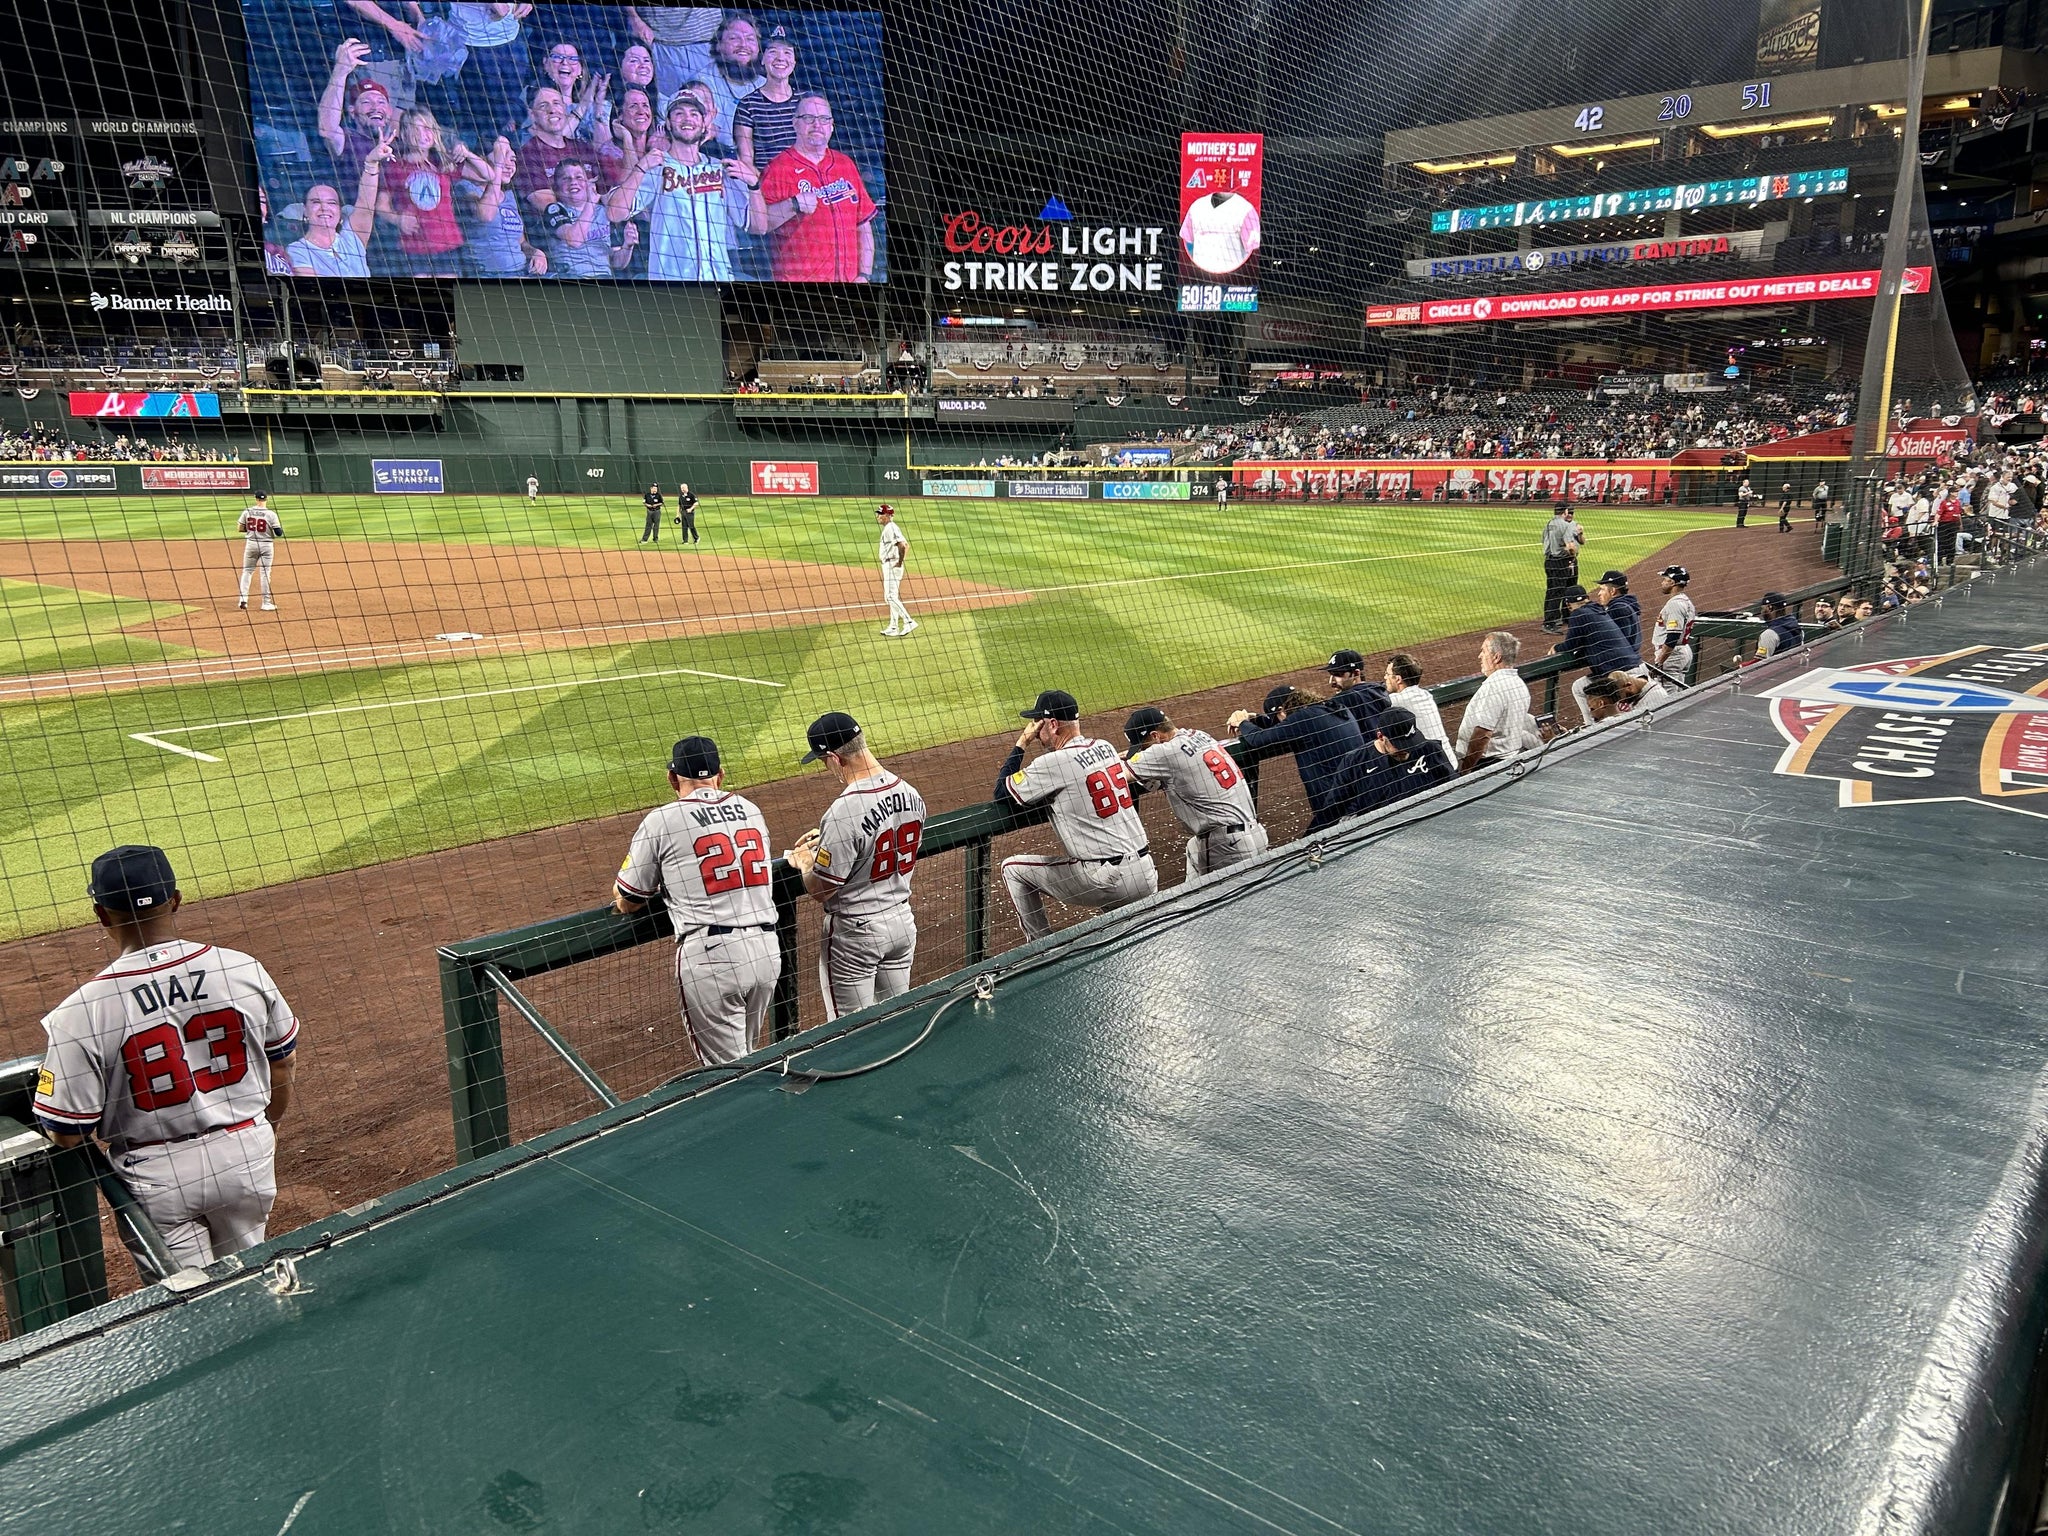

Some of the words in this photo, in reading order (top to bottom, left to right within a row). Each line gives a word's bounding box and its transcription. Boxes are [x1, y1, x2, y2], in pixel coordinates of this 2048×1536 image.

[1741, 82, 1771, 110] 51
[1657, 94, 1692, 121] 20
[1574, 106, 1603, 132] 42
[3, 121, 68, 133] CHAMPIONS
[92, 122, 128, 133] WORLD
[132, 122, 197, 134] CHAMPIONS
[1187, 142, 1236, 155] MOTHER'S
[1238, 142, 1257, 156] DAY
[662, 166, 722, 192] Braves
[1832, 169, 1846, 178] GB
[1743, 178, 1756, 187] GB
[1798, 184, 1806, 194] 3
[1815, 183, 1823, 192] 3
[1828, 180, 1848, 191] 2.0
[1709, 193, 1717, 203] 3
[1726, 192, 1733, 202] 3
[1739, 189, 1757, 200] 2.0
[1629, 202, 1636, 211] 3
[1644, 200, 1651, 210] 3
[0, 212, 15, 224] LD
[18, 212, 49, 224] CARD
[110, 212, 126, 224] NL
[129, 212, 197, 224] CHAMPIONS
[943, 210, 1054, 254] Coors
[1061, 226, 1163, 255] LIGHT
[114, 244, 152, 254] CHAMPIONS
[1431, 255, 1522, 277] ESTRELLA
[1633, 236, 1729, 261] CANTINA
[943, 261, 1059, 291] STRIKE
[1070, 262, 1163, 291] ZONE
[1223, 293, 1258, 302] AVNET
[1501, 297, 1577, 313] DOWNLOAD
[1580, 294, 1609, 308] OUR
[1612, 291, 1640, 306] APP
[1642, 289, 1671, 304] FOR
[1674, 286, 1730, 301] STRIKE
[1731, 284, 1760, 299] OUT
[1763, 280, 1817, 297] METER
[1818, 276, 1872, 293] DEALS
[110, 294, 172, 310] Banner
[175, 294, 232, 311] Health
[1225, 302, 1252, 310] CARES
[1428, 303, 1472, 318] CIRCLE
[939, 401, 963, 411] VALDO,
[75, 474, 111, 483] PEPSI
[163, 470, 215, 479] MEMBERSHIPS
[216, 471, 226, 479] ON
[228, 471, 245, 479] SALE
[282, 467, 300, 476] 413
[391, 468, 430, 476] ENERGY
[586, 468, 605, 478] 407
[758, 464, 811, 491] fry's
[884, 470, 900, 480] 413
[2, 474, 40, 484] PEPSI
[392, 476, 440, 484] TRANSFER
[1024, 484, 1052, 495] Banner
[1055, 484, 1083, 496] Health
[1113, 485, 1141, 497] COX
[1151, 485, 1179, 497] COX
[1192, 485, 1209, 496] 374
[246, 516, 267, 533] 28
[1946, 652, 2048, 683] FIELD
[1851, 712, 1954, 778] CHASE
[1073, 745, 1116, 770] HEFNER
[2017, 743, 2048, 769] HOME
[1086, 762, 1134, 819] 85
[690, 803, 748, 828] WEISS
[870, 820, 922, 884] 89
[693, 828, 769, 896] 22
[130, 970, 208, 1016] DIAZ
[120, 1007, 249, 1112] 83
